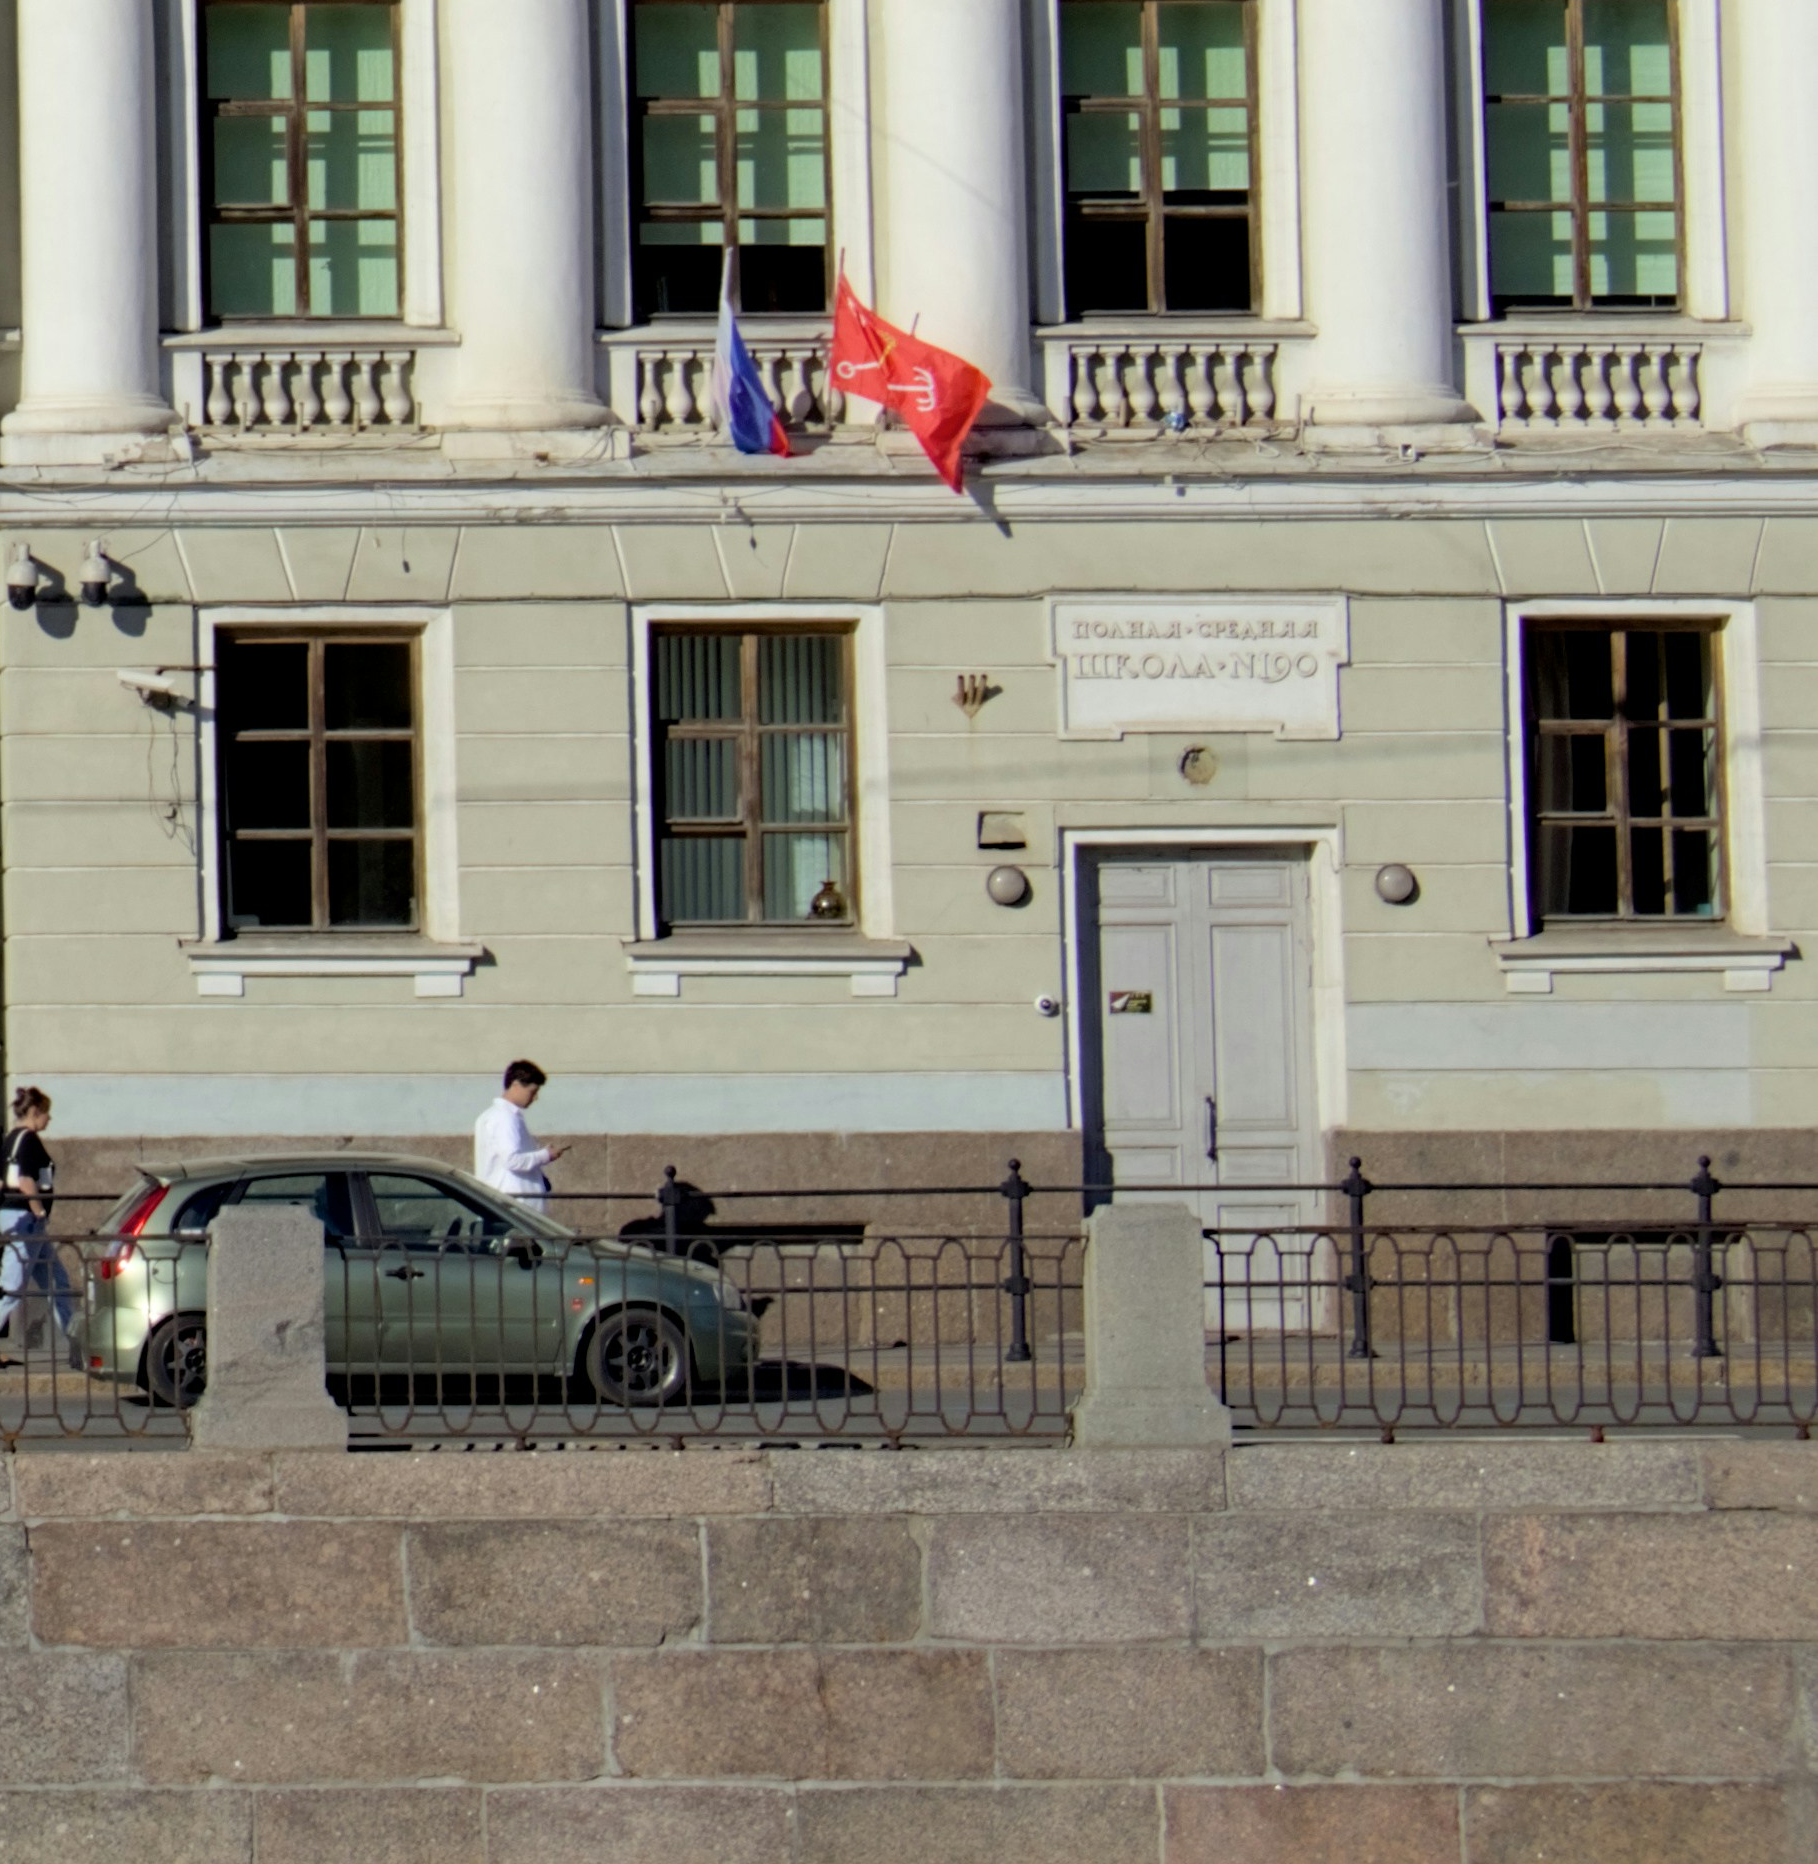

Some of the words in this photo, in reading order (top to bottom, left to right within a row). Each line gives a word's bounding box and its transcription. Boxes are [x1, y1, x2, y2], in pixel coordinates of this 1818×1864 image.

[1072, 620, 1182, 639] ПОЛНАЯ
[1196, 620, 1318, 640] СРЕДНЯЯ
[1072, 653, 1215, 679] ШКОЛА
